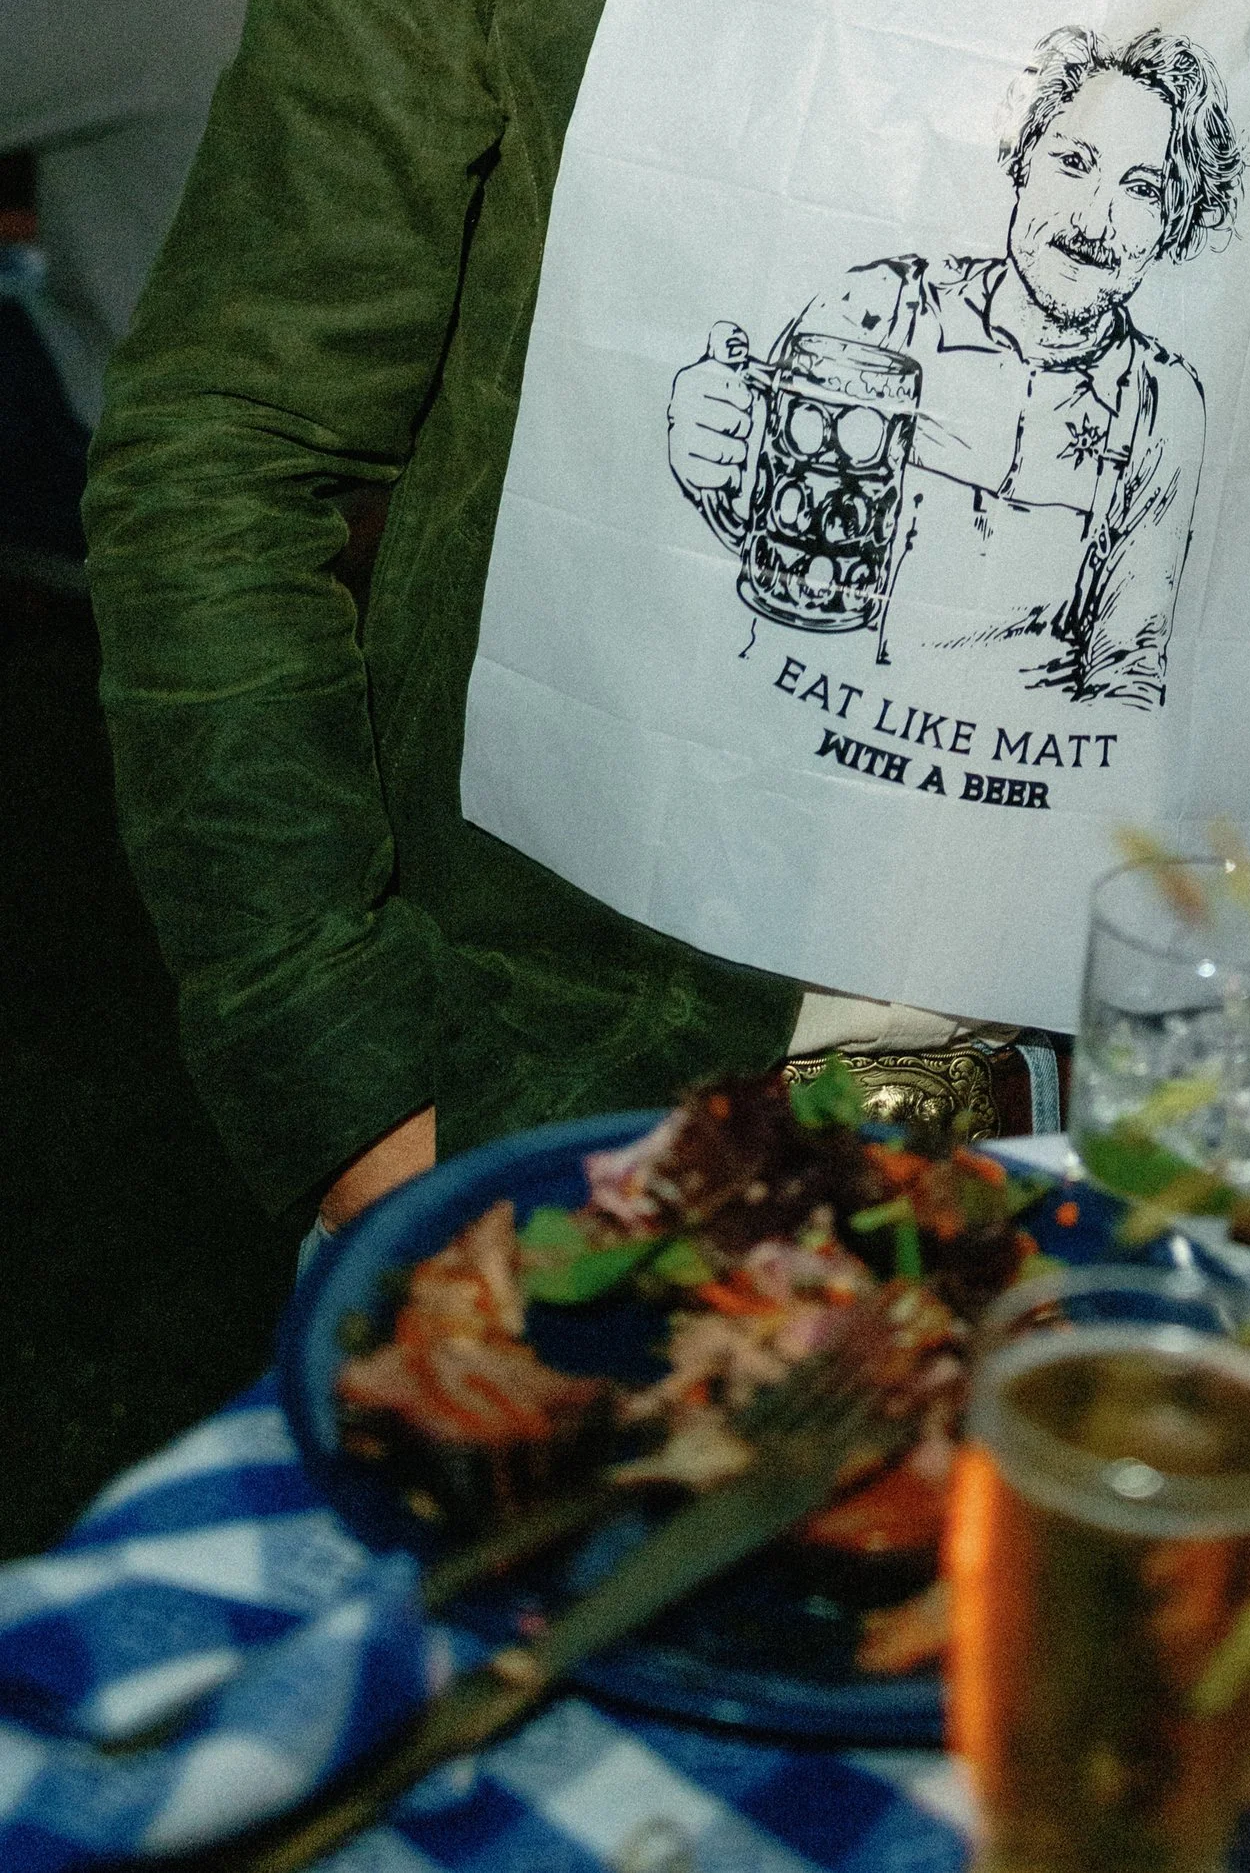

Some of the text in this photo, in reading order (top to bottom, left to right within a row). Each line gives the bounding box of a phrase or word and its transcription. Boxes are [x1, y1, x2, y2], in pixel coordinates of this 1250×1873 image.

[774, 656, 1117, 767] EAT LIKE MATT
[815, 728, 1051, 809] WITH A BEER
